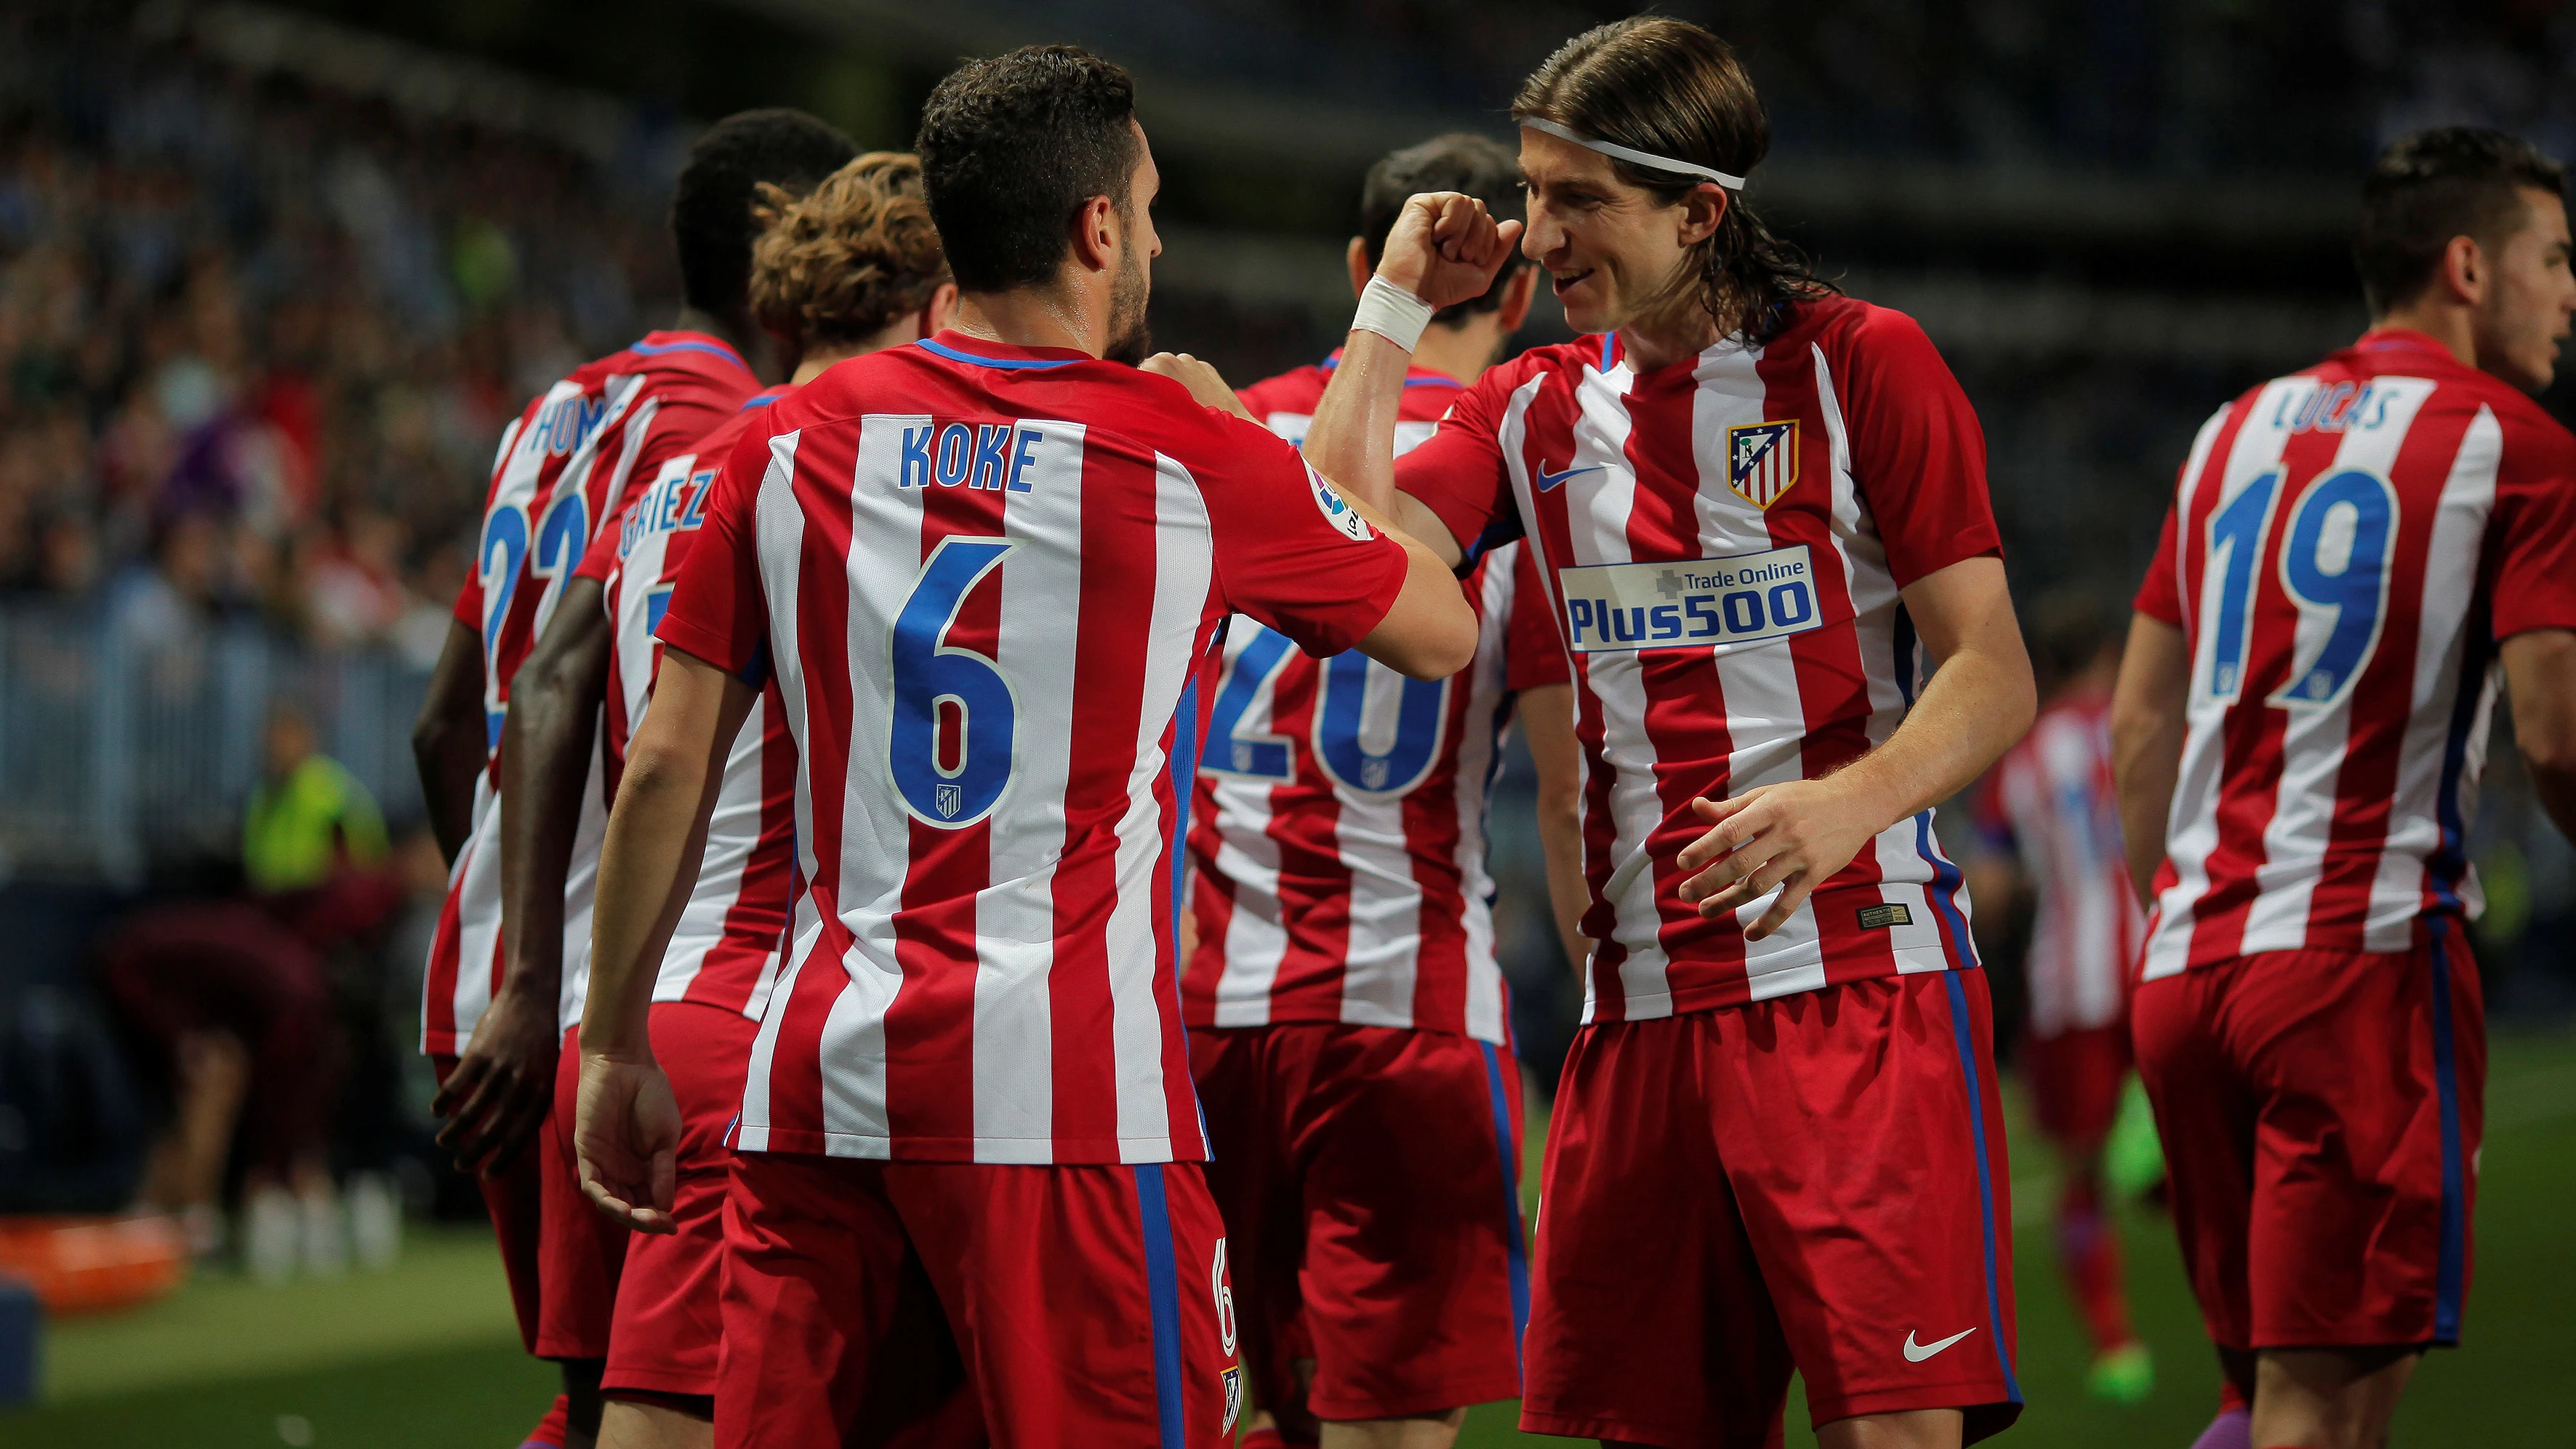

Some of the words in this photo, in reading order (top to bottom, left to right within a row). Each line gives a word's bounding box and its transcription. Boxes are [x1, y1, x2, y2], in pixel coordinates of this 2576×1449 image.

[521, 395, 624, 457] HOM
[2271, 381, 2399, 434] LUCAS
[899, 423, 1046, 494] KOKE
[619, 467, 720, 562] GRIEZ
[1685, 571, 1735, 590] Trade
[1738, 562, 1805, 585] Online
[2204, 462, 2401, 709] 19
[1568, 581, 1813, 643] Plus500
[884, 534, 1032, 830] 6
[1211, 1236, 1237, 1357] 6
